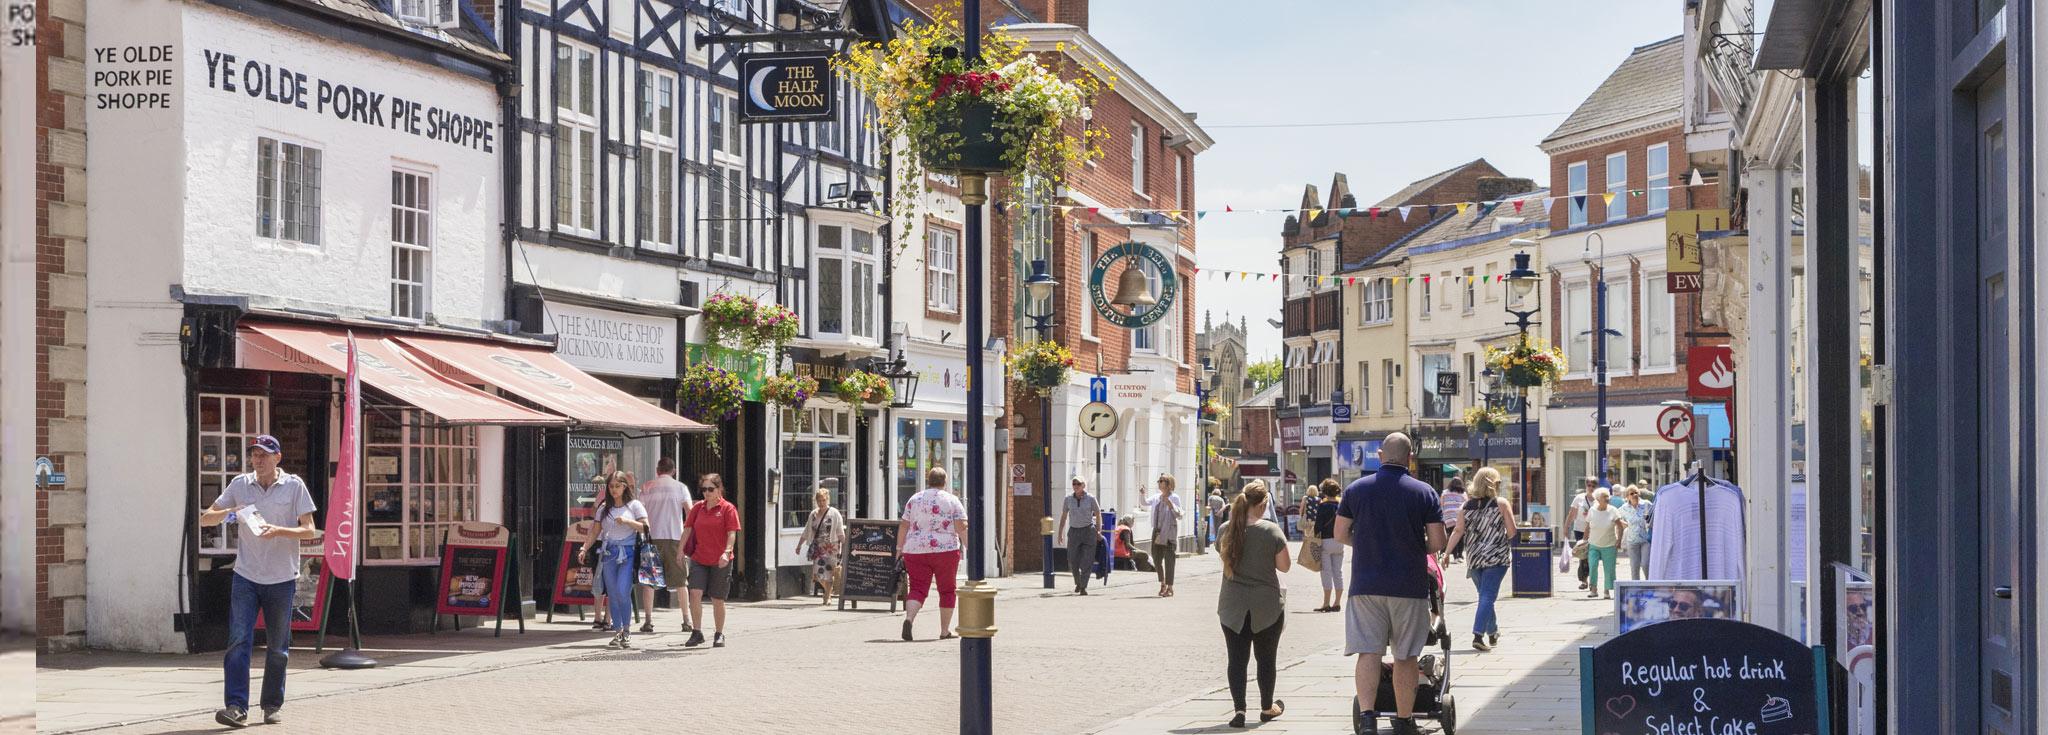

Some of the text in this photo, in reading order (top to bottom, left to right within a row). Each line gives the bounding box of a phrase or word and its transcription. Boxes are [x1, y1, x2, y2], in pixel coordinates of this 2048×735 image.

[94, 45, 173, 63] YE OLDE
[94, 70, 173, 86] PORK PIE
[785, 66, 815, 79] THE
[778, 80, 819, 93] HALF
[97, 93, 170, 109] SHOPPE
[204, 49, 493, 154] YE OLDE PORK PIE SHOPPE
[774, 94, 824, 107] MOON
[1092, 285, 1125, 325] SHOPPIN
[558, 314, 664, 345] THE SAUSAGE SHOP
[557, 337, 664, 364] DICKINSON & MORRIS
[795, 363, 811, 377] THE
[569, 438, 601, 449] SAUSAGES
[607, 440, 622, 450] BACON
[569, 483, 597, 493] AVAILABLE
[1621, 655, 1787, 697] Regular hot drink
[1693, 687, 1711, 712] &
[1645, 715, 1757, 735] Select Cake
